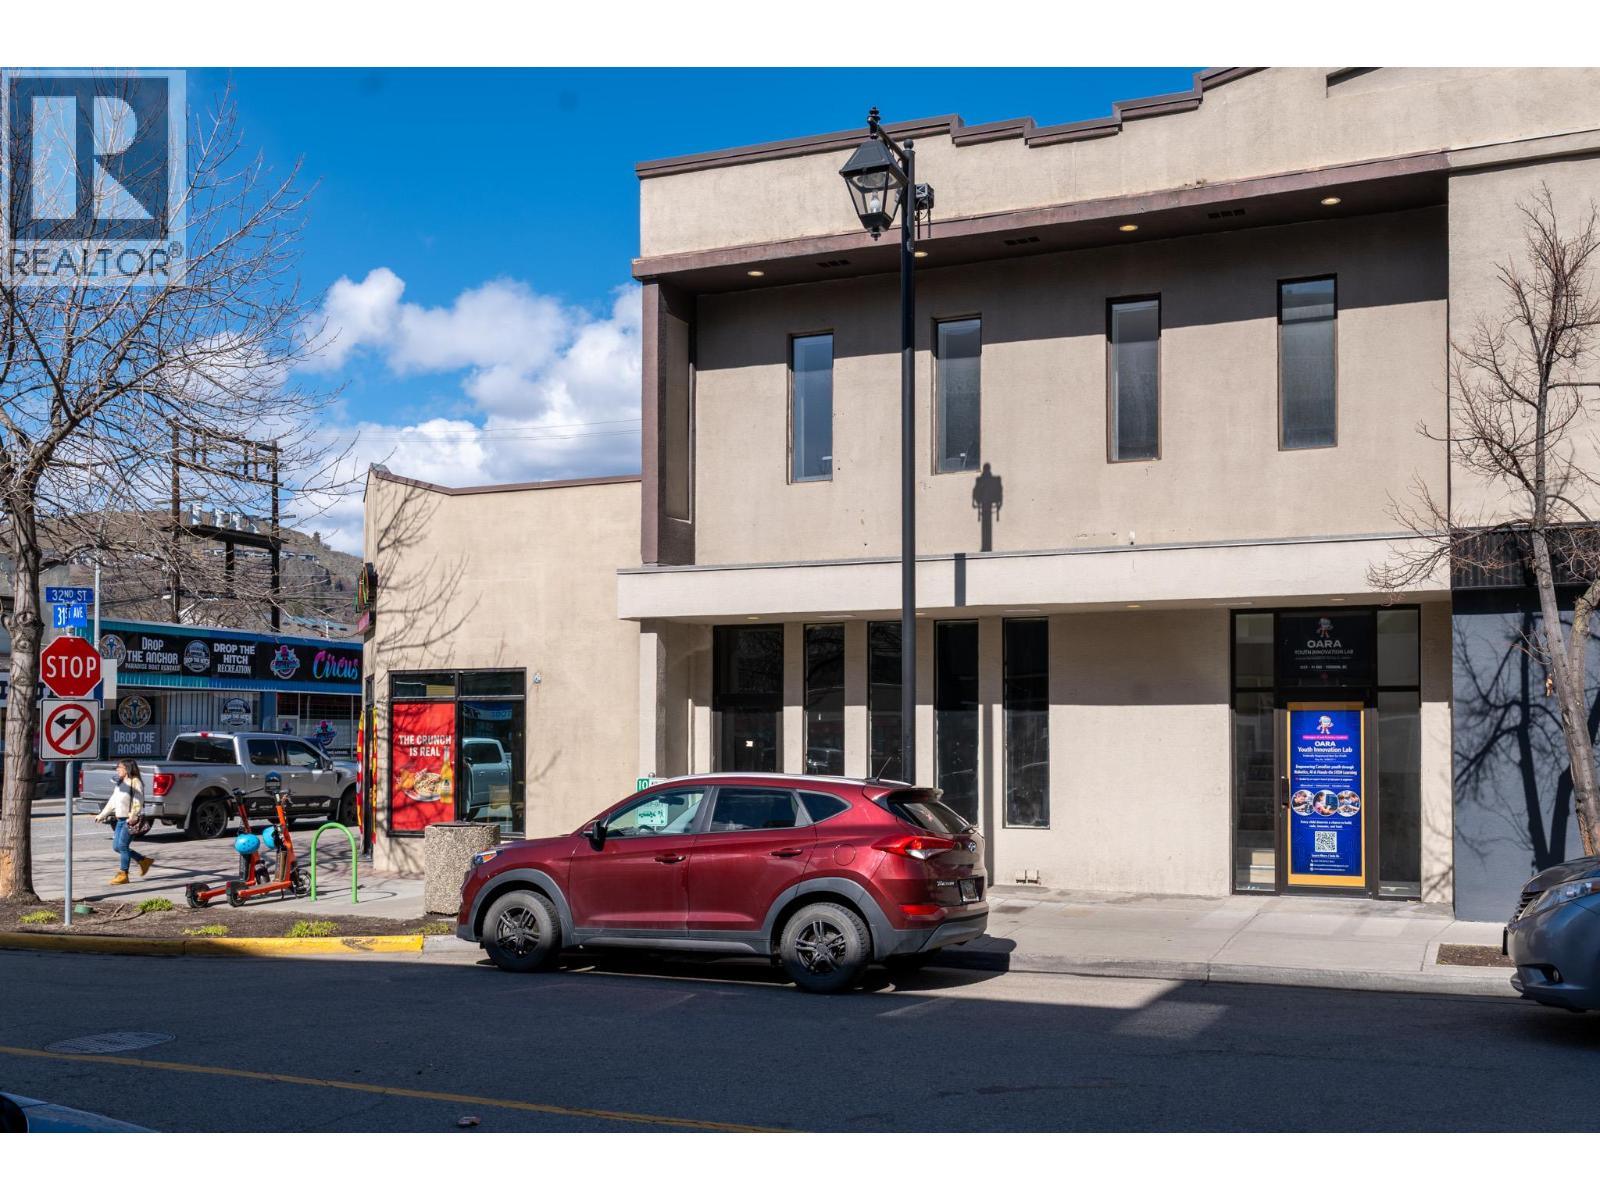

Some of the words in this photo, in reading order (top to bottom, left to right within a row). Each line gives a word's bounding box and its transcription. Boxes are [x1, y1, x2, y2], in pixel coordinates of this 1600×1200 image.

[52, 590, 74, 601] 32ND
[77, 590, 87, 601] ST
[73, 607, 83, 618] AVE
[142, 637, 164, 650] DROP
[213, 643, 238, 654] DROP
[239, 645, 256, 655] THE
[1307, 640, 1342, 648] OARA
[127, 650, 144, 662] THE
[146, 652, 178, 665] ANCHOR
[223, 654, 249, 664] HITCH
[46, 655, 97, 679] STOP
[217, 664, 252, 674] RECREATION
[313, 650, 359, 680] Circus
[114, 730, 137, 743] DROP
[138, 731, 156, 743] THE
[399, 735, 415, 745] THE
[416, 735, 452, 745] CRUNCH
[118, 743, 152, 755] ANCHOR
[409, 746, 418, 757] IS
[420, 746, 440, 757] REAL
[638, 780, 648, 791] 10
